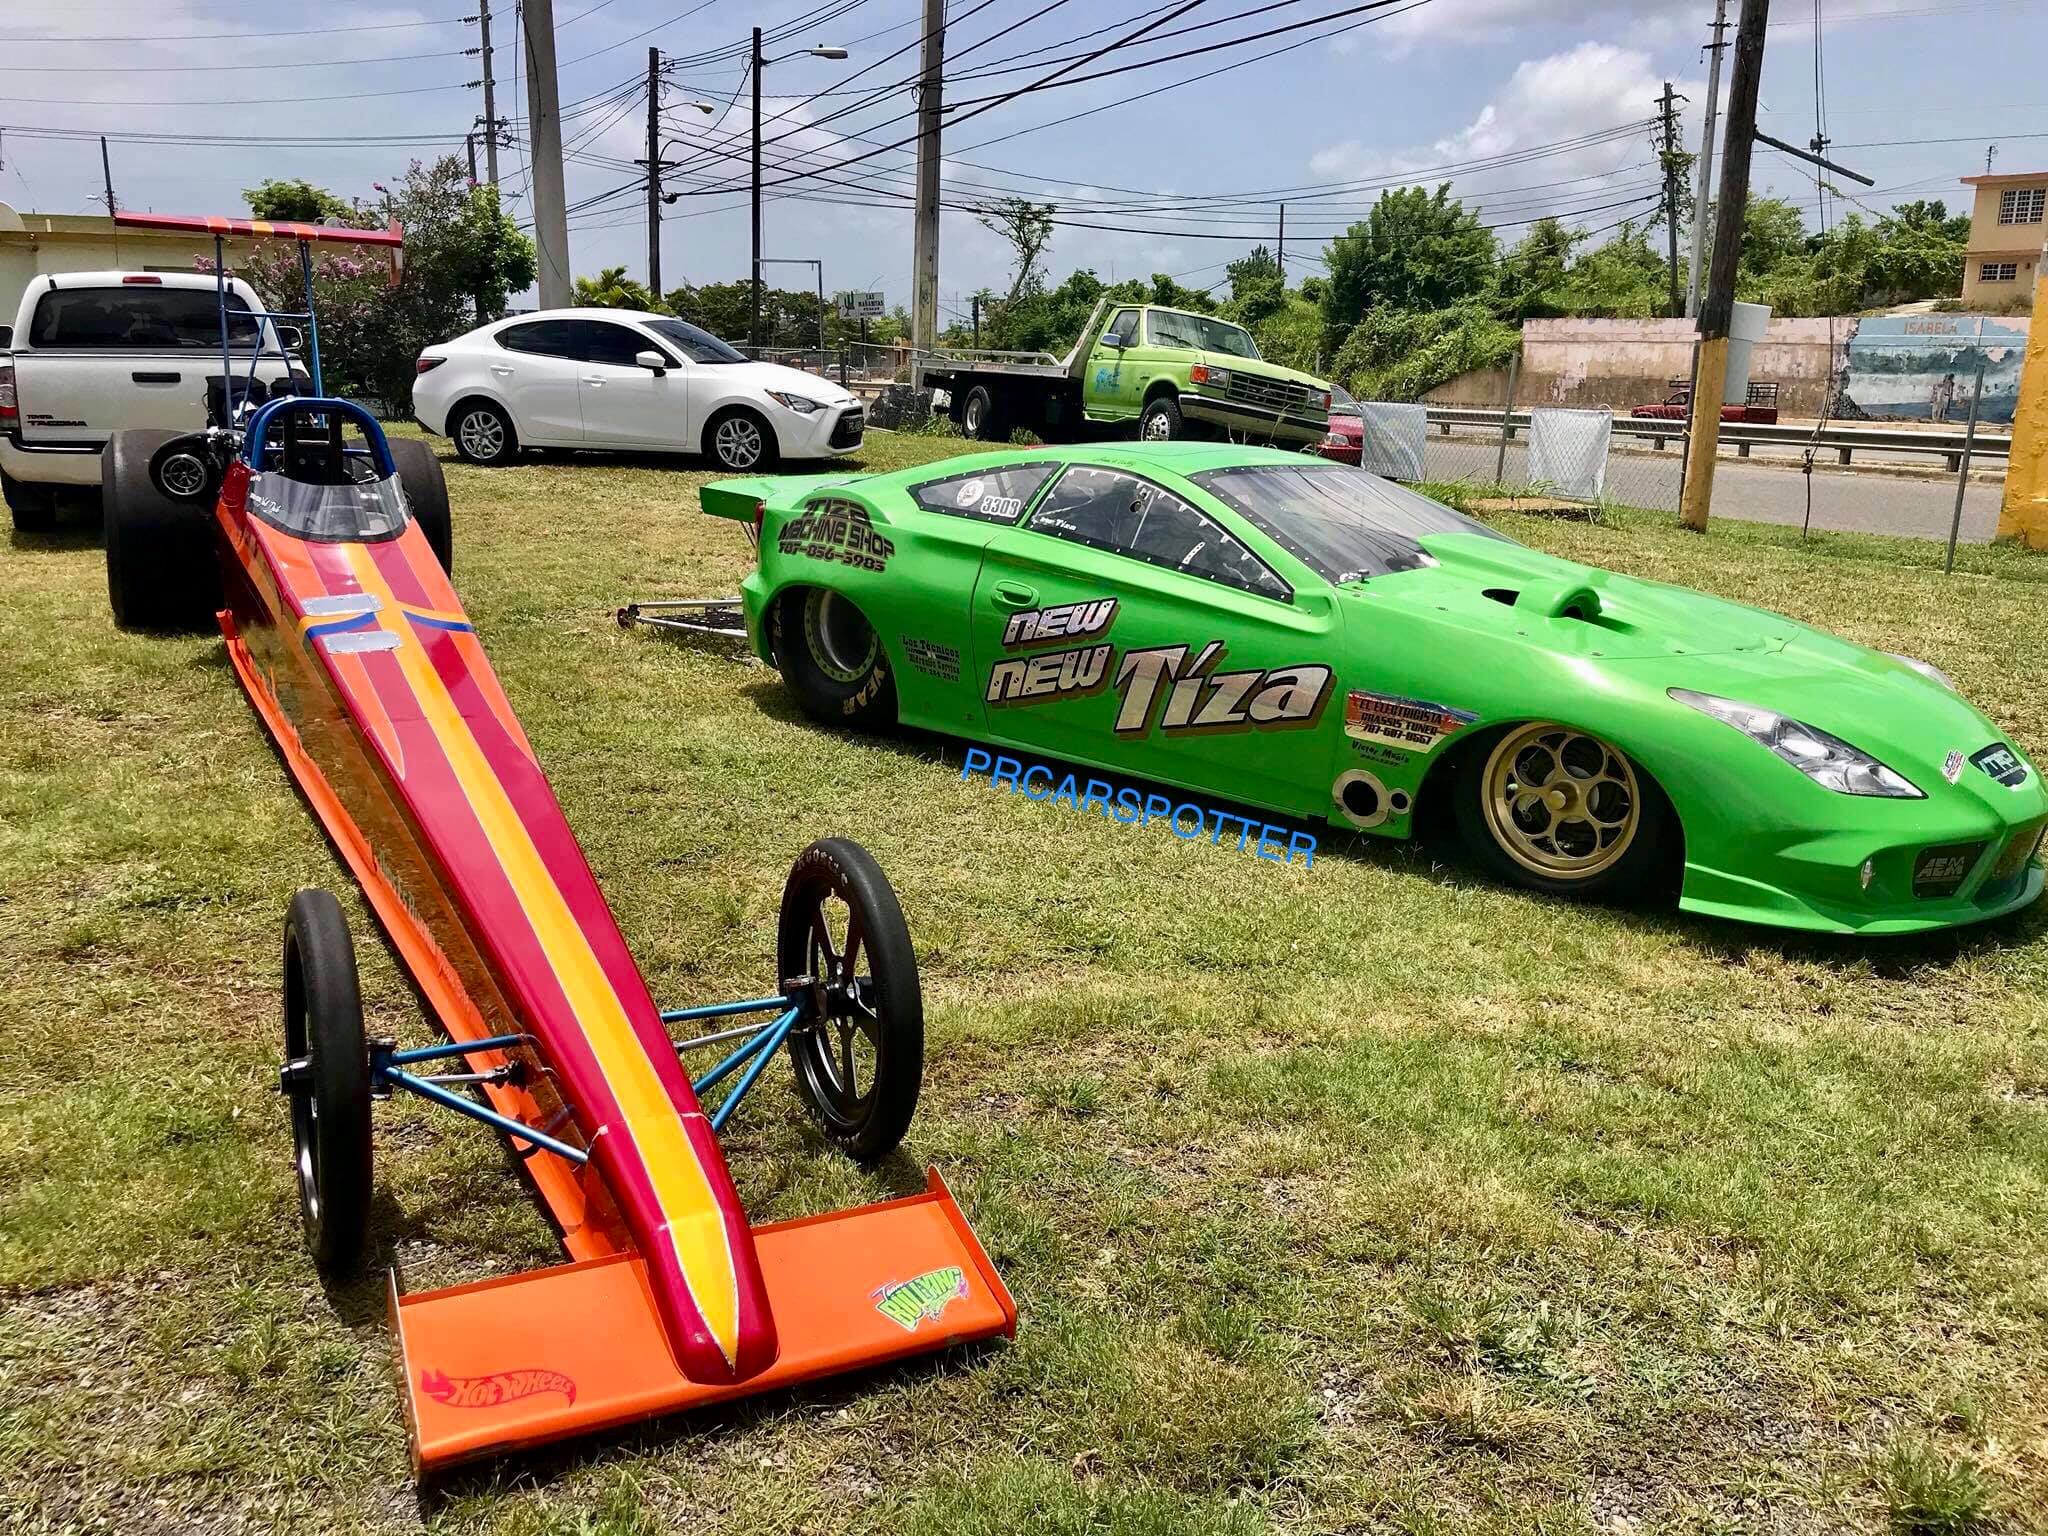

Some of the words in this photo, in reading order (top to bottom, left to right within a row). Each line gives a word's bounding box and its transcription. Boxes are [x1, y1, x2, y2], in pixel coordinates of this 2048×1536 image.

[1904, 321, 1957, 335] ISABELA
[778, 514, 848, 546] MACHINE
[847, 521, 895, 560] SHOP
[1406, 720, 1438, 736] TUNER
